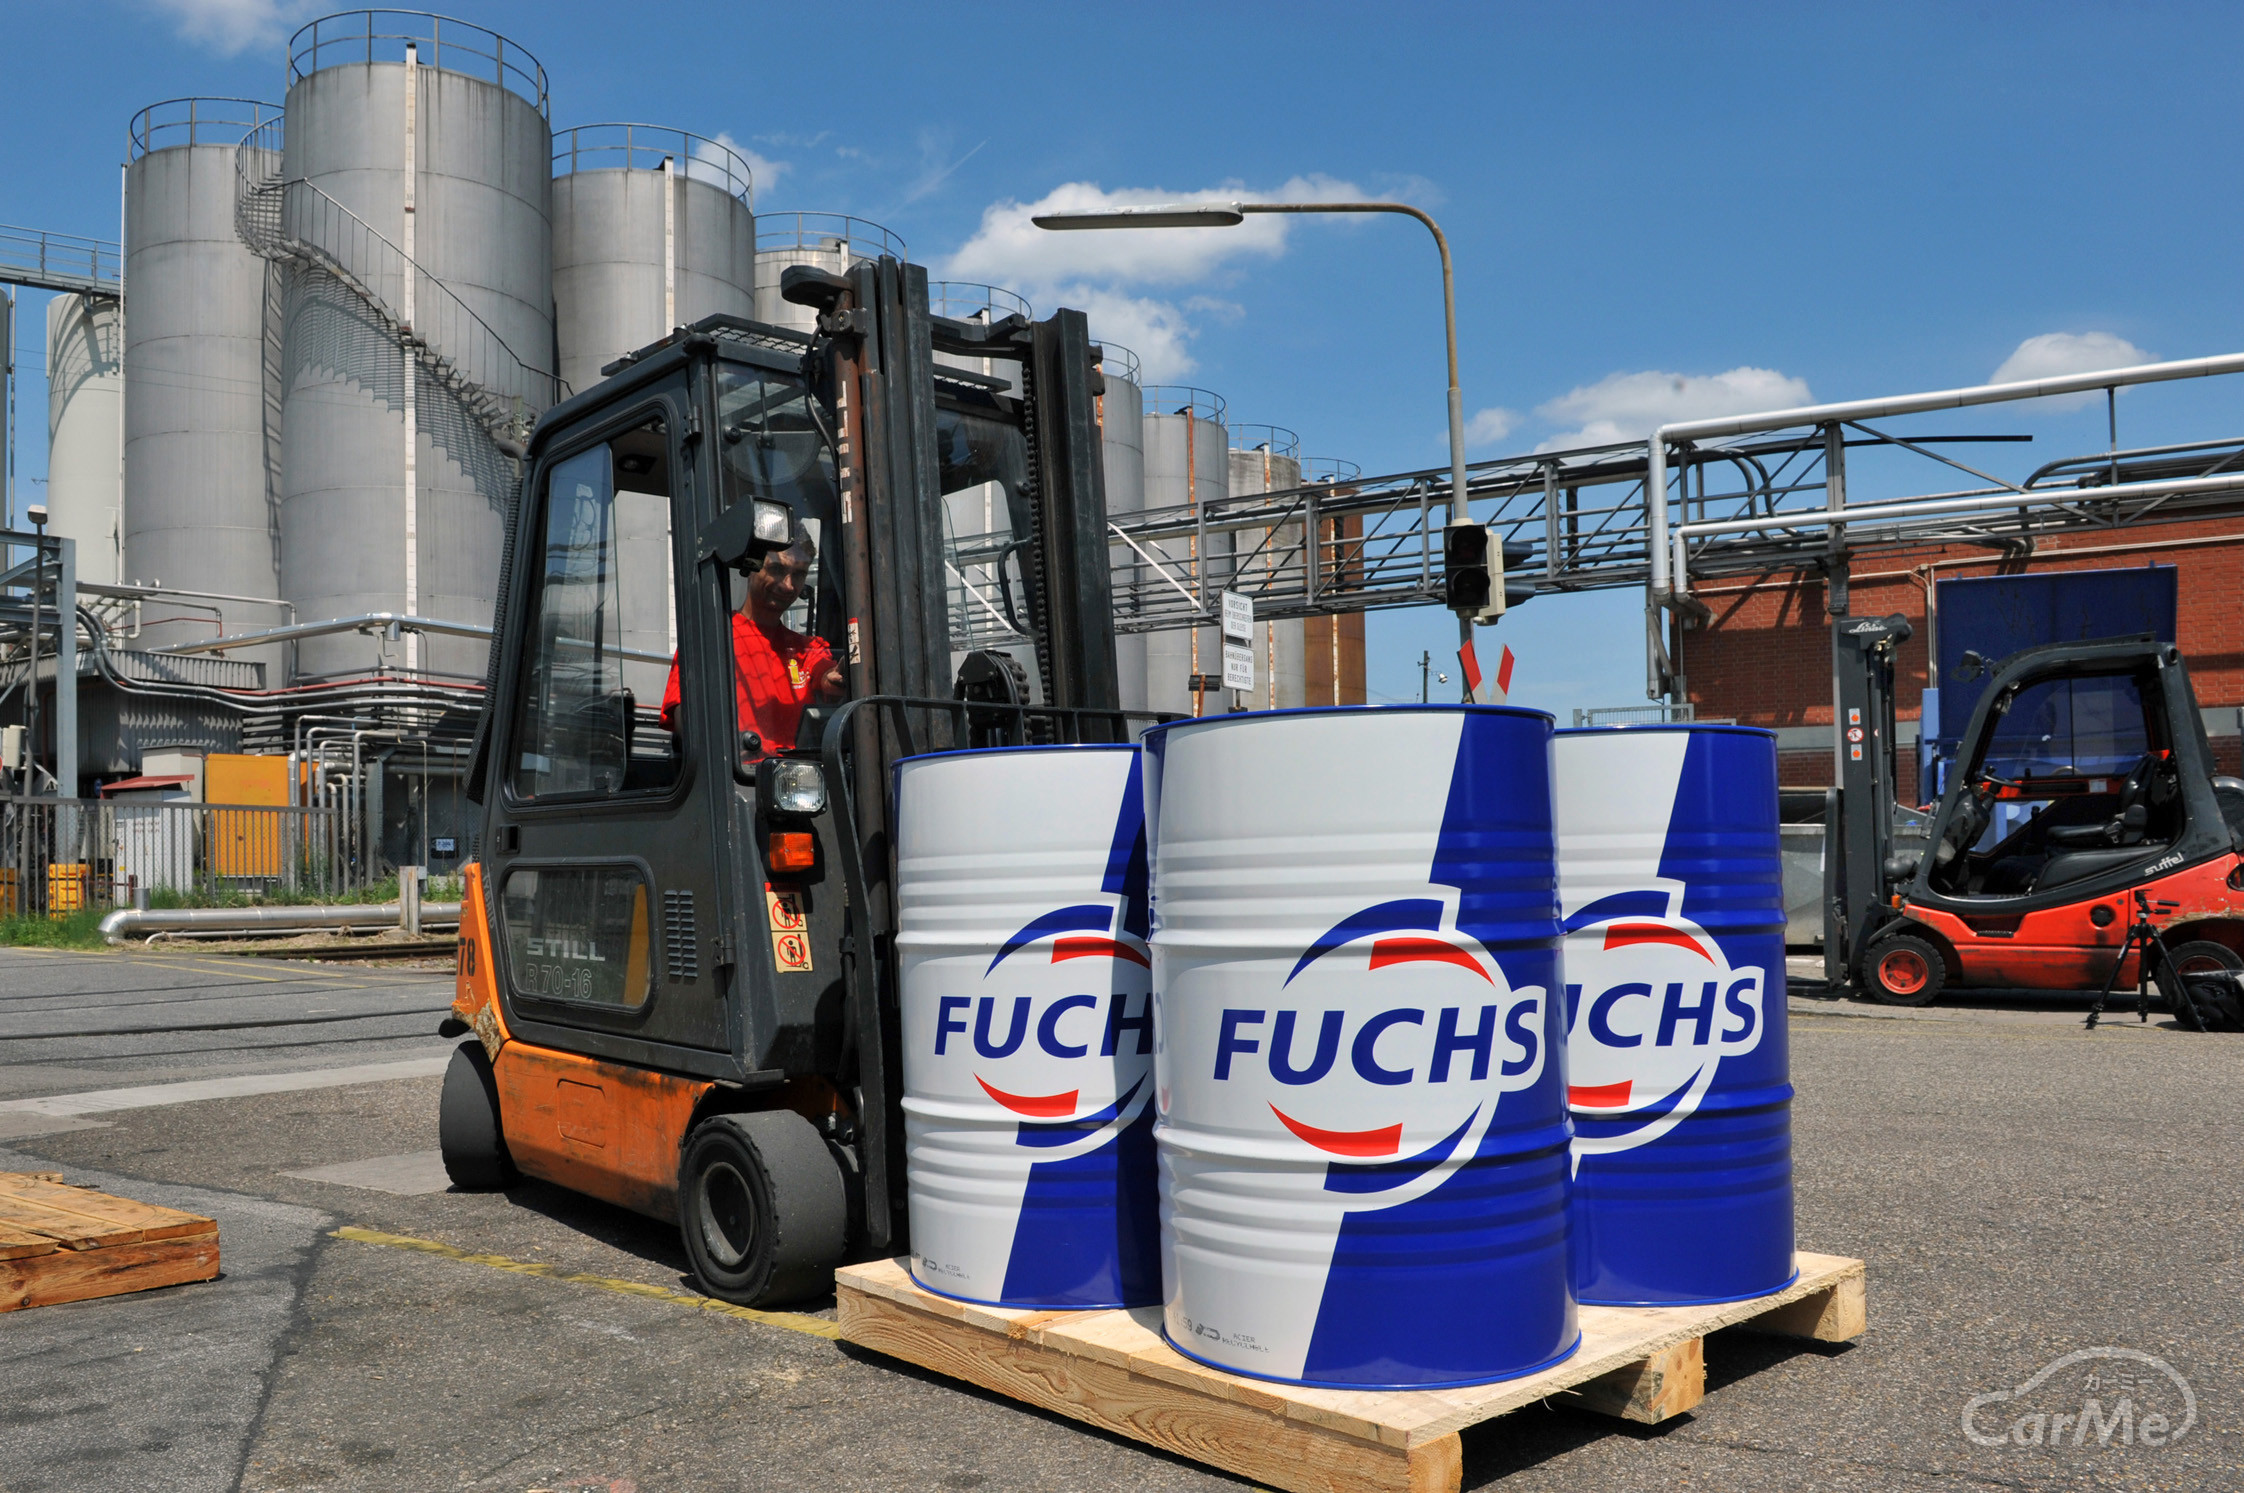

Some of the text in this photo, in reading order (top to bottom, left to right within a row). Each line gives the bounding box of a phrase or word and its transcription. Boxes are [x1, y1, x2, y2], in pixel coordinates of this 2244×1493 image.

[1228, 599, 1248, 612] VORSICHT
[1231, 663, 1248, 673] NUR FÜR
[526, 937, 606, 962] STILL
[525, 963, 593, 999] R 70-16
[934, 993, 1153, 1059] FUCH
[1566, 977, 1757, 1048] CHS
[1213, 999, 1538, 1086] FUCHS
[1233, 1332, 1256, 1343] ACIER
